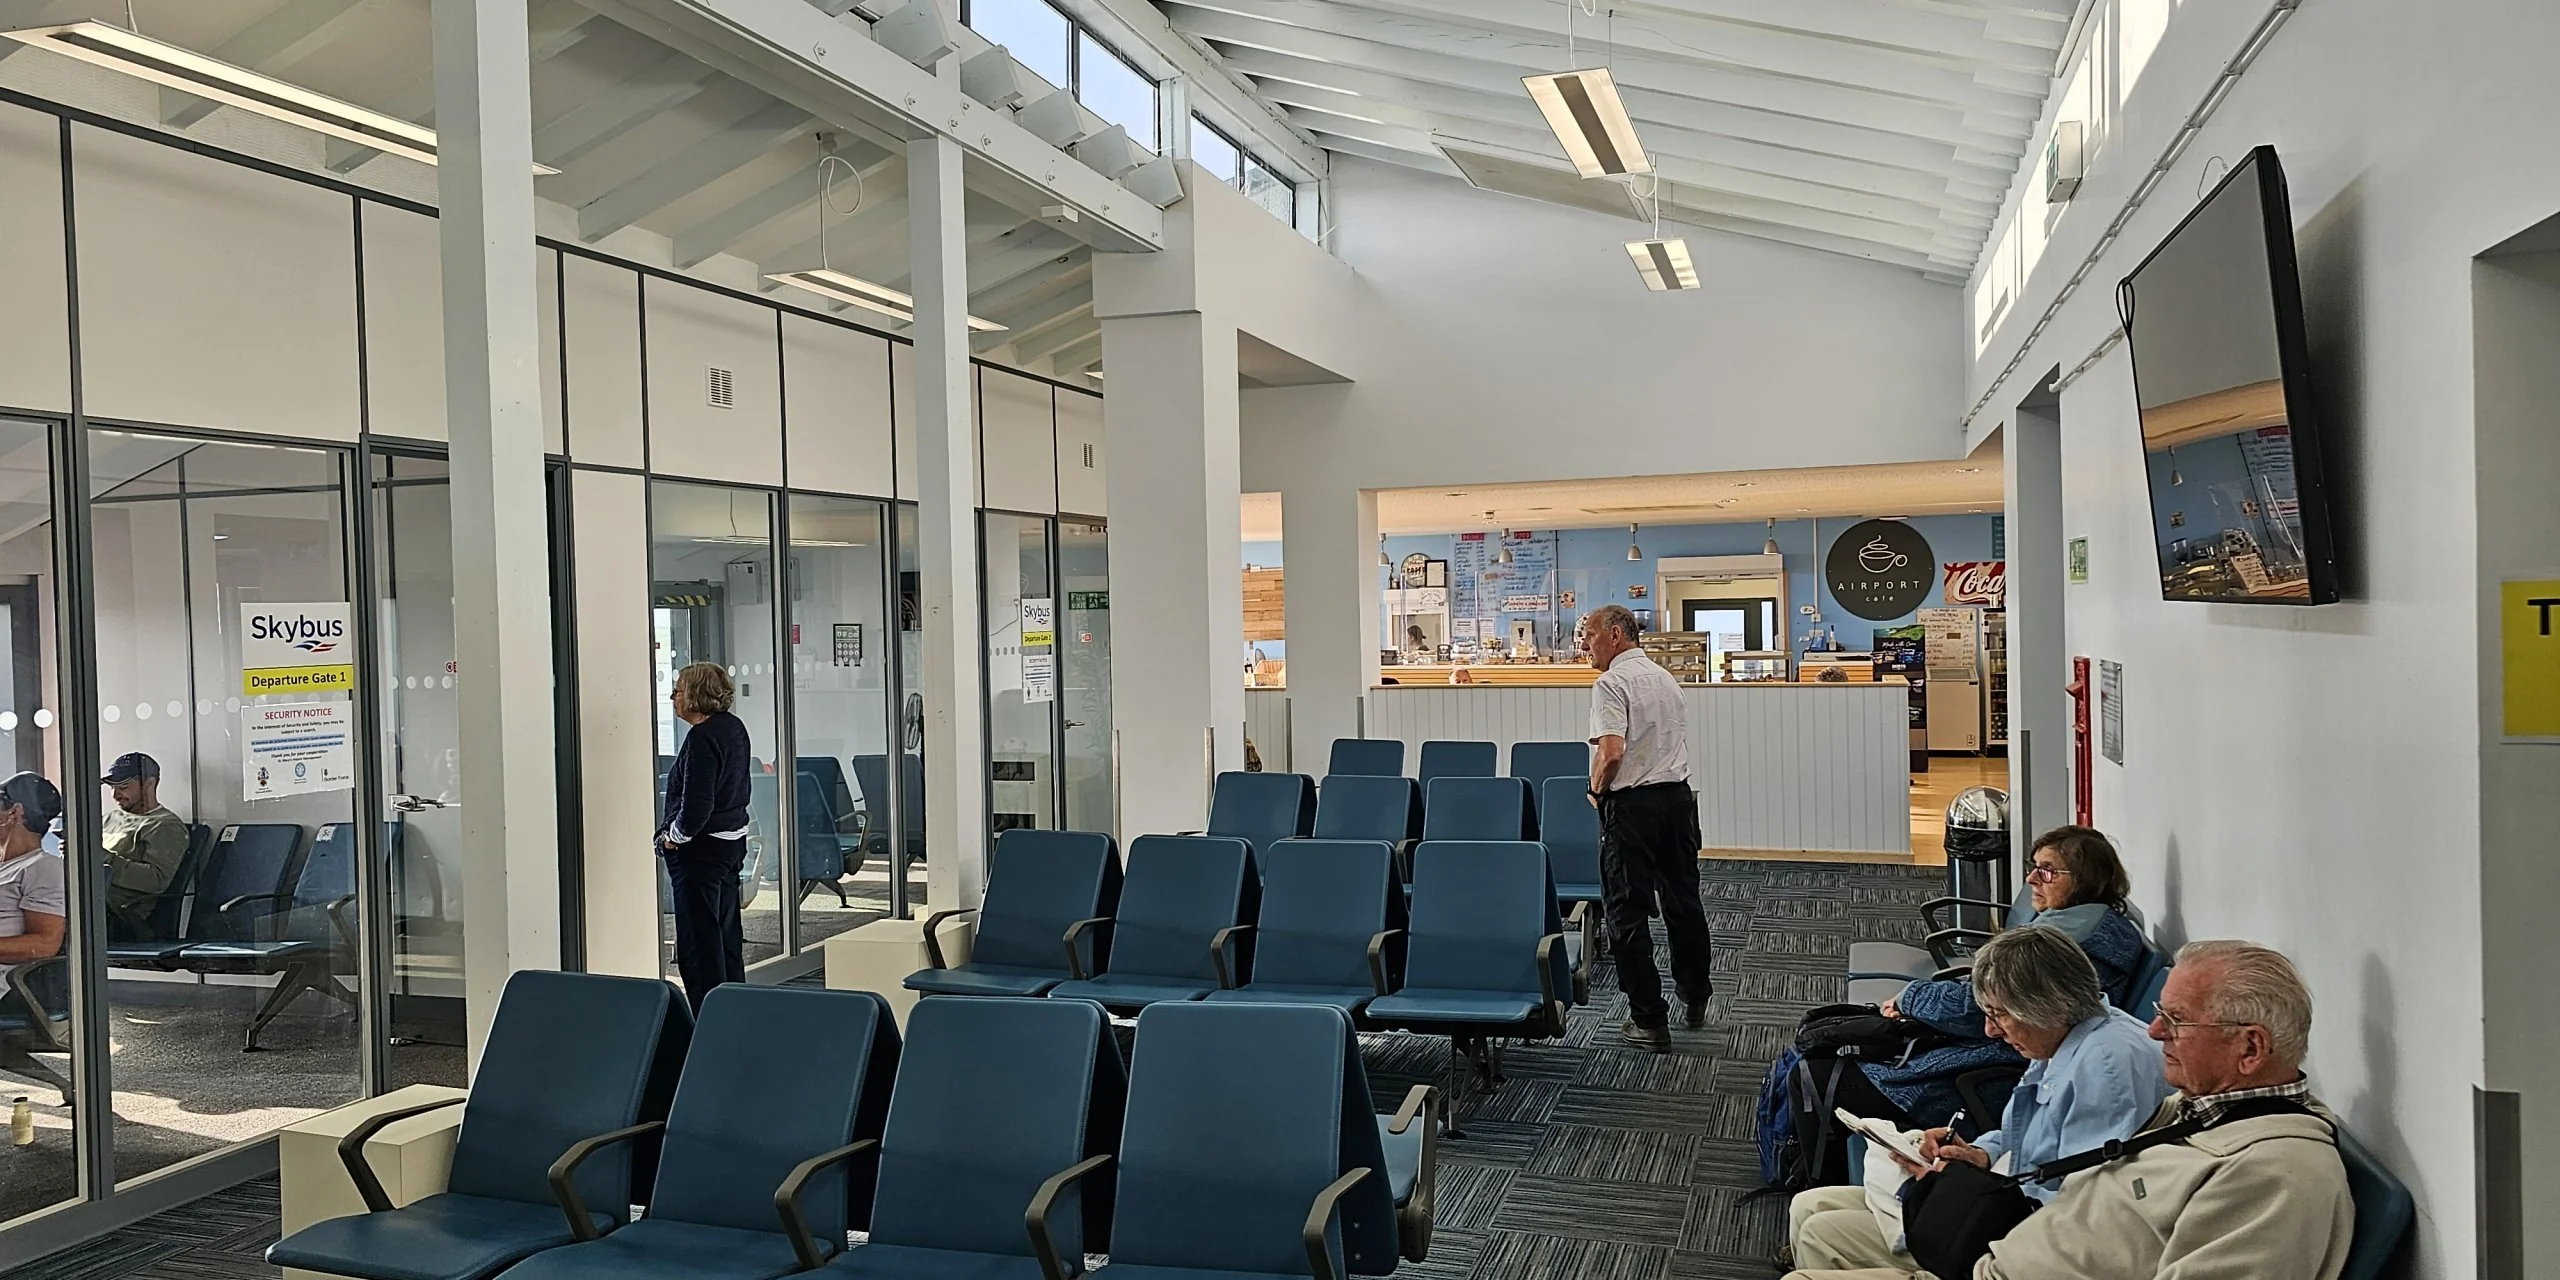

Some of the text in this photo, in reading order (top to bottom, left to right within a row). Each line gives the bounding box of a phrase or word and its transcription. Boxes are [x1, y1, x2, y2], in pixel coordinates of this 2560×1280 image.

[1838, 580, 1919, 591] AIRPORT
[1953, 567, 2005, 602] Coca
[1071, 593, 1086, 601] Fire
[1024, 605, 1050, 620] Skybus
[251, 614, 343, 643] Skybus
[1024, 635, 1040, 643] Departure
[251, 671, 346, 689] Departure Gate 1
[264, 708, 332, 720] SECURITY NOTICE
